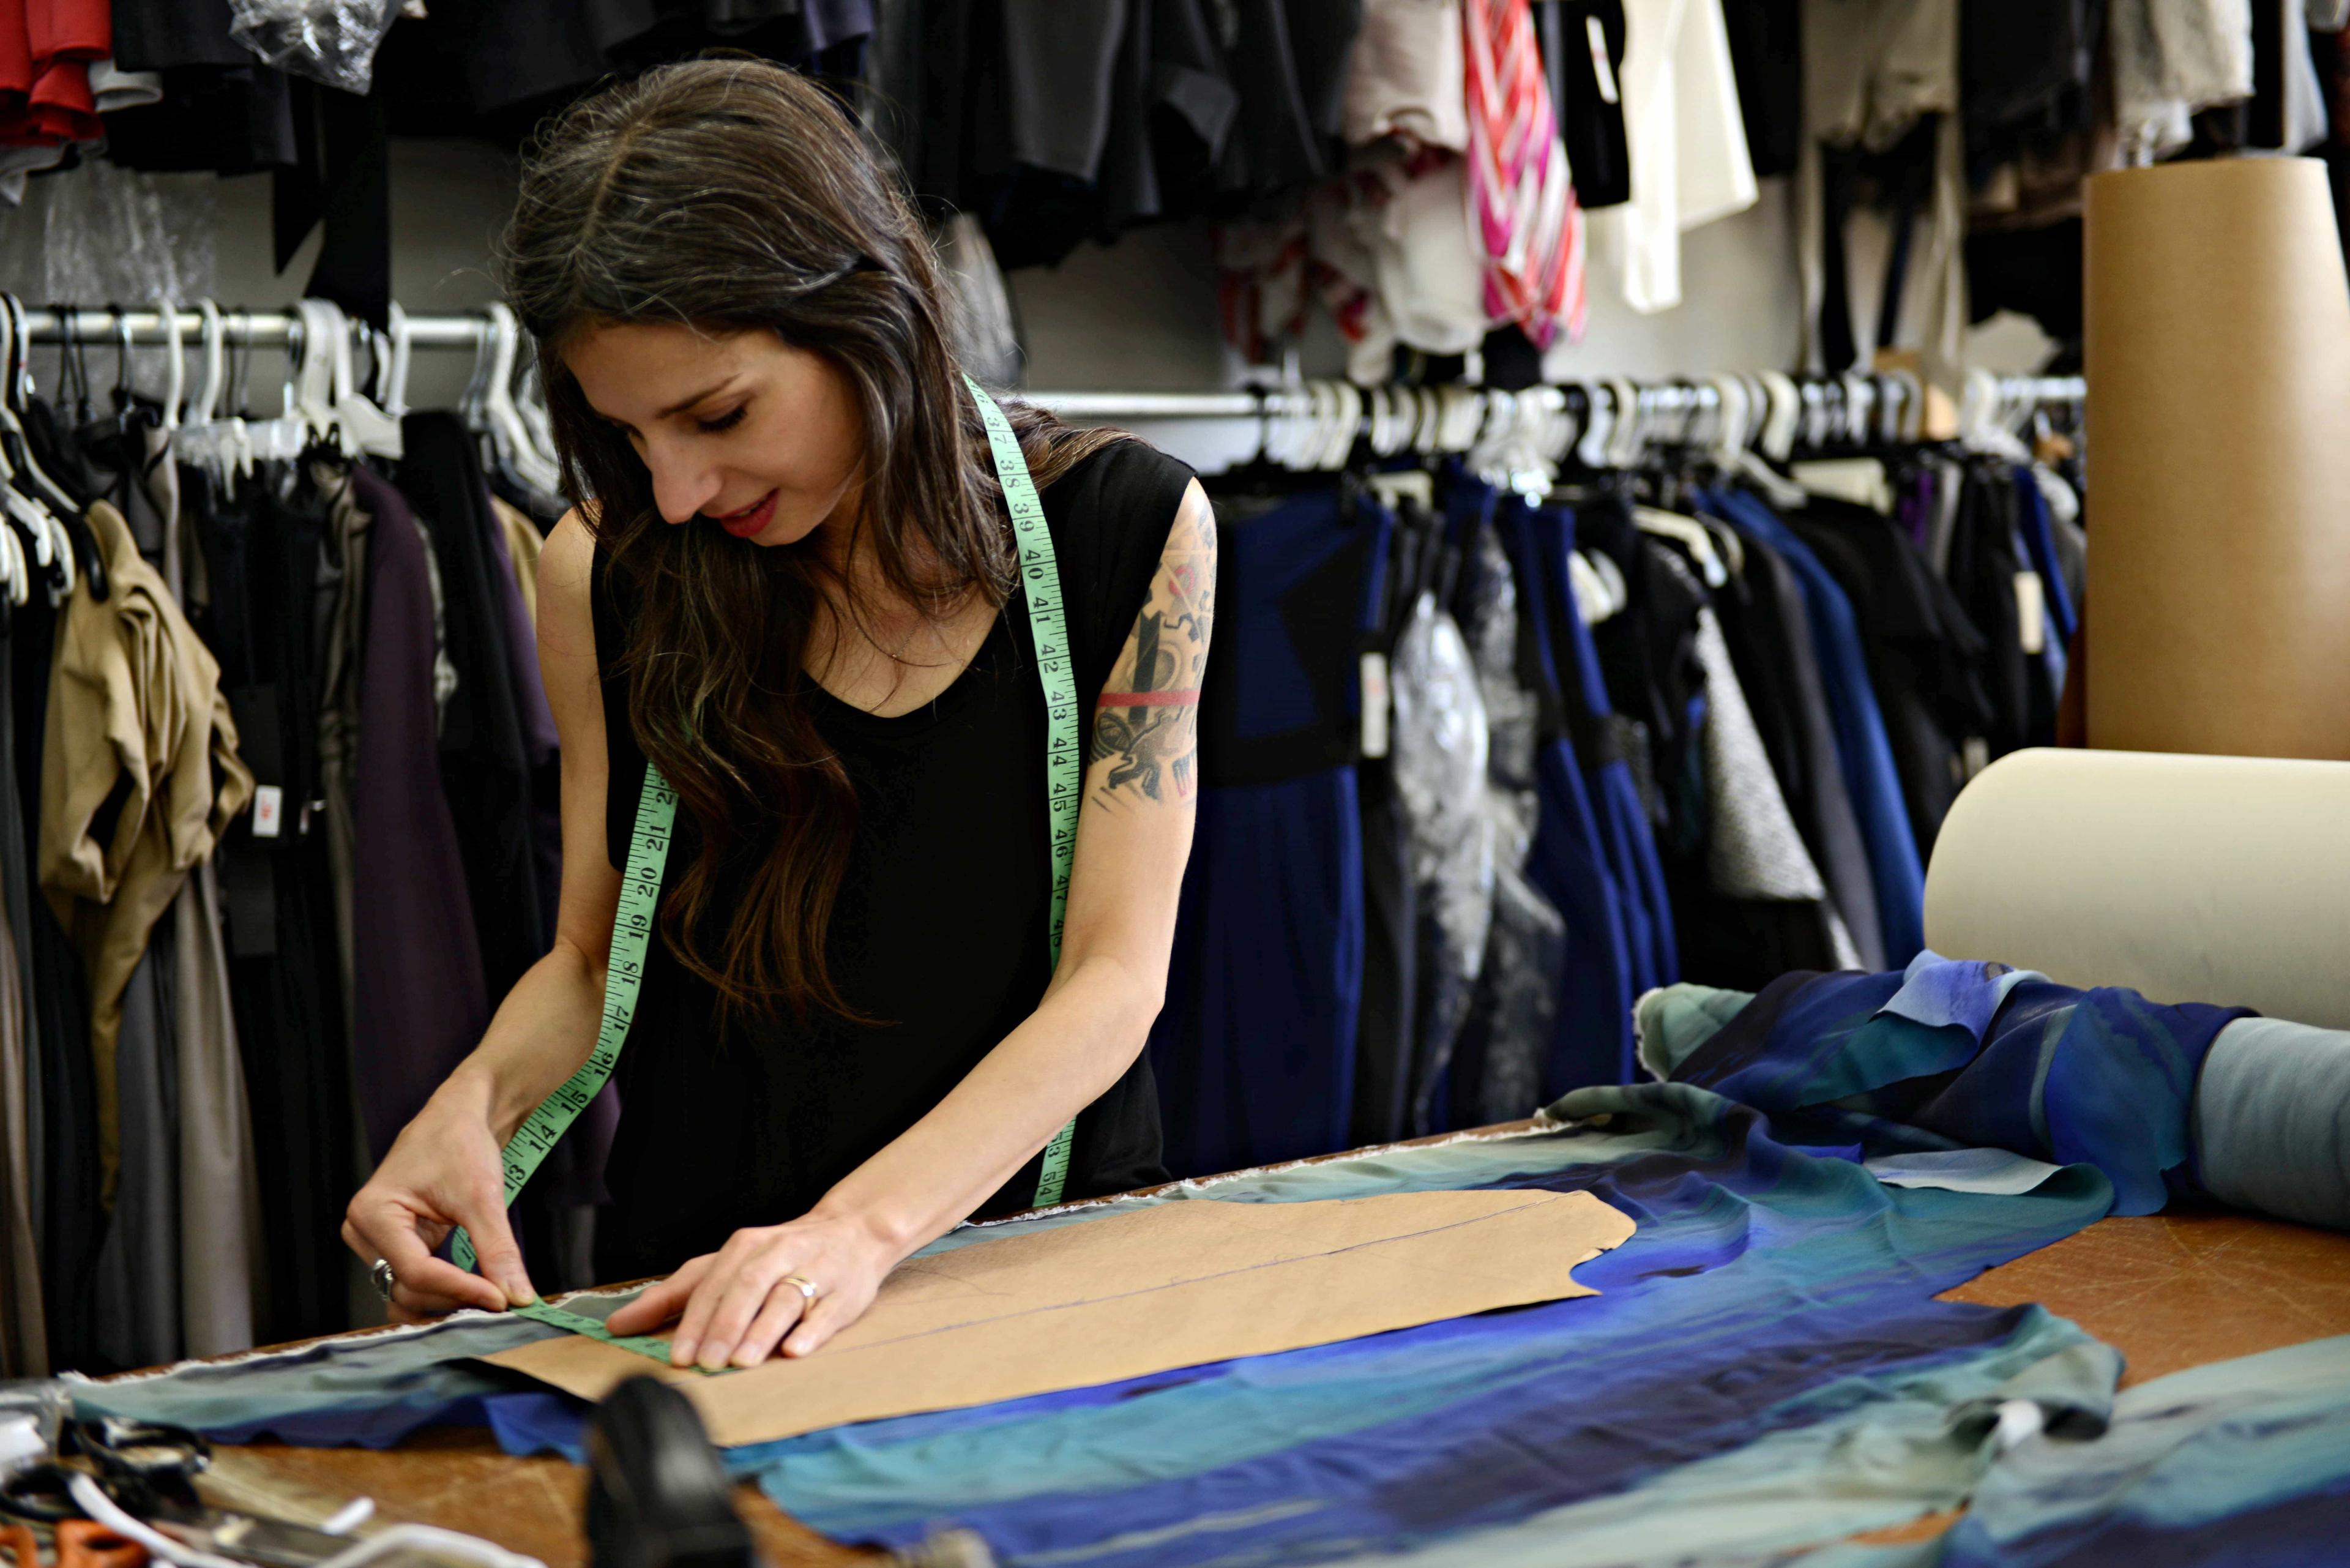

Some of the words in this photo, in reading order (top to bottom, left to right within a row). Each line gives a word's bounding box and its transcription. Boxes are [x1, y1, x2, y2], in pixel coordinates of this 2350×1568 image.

[987, 417, 1007, 444] 37
[999, 460, 1020, 489] 38
[1013, 502, 1035, 533] 39
[1024, 549, 1045, 580] 40
[1033, 596, 1051, 624] 41
[1042, 644, 1059, 674] 42
[1050, 690, 1067, 721] 43
[1053, 737, 1068, 767] 44
[656, 777, 673, 805] 2
[1053, 783, 1067, 812] 45
[646, 825, 667, 852] 21
[1055, 829, 1069, 858] 46
[637, 867, 657, 898] 20
[1056, 874, 1069, 900] 47
[628, 914, 648, 941] 19
[622, 961, 639, 987] 18
[614, 1006, 629, 1033] 17
[594, 1052, 614, 1077] 16
[560, 1089, 589, 1115] 15
[529, 1124, 557, 1154] 14
[504, 1163, 527, 1193] 13
[1040, 1171, 1056, 1196] 54
